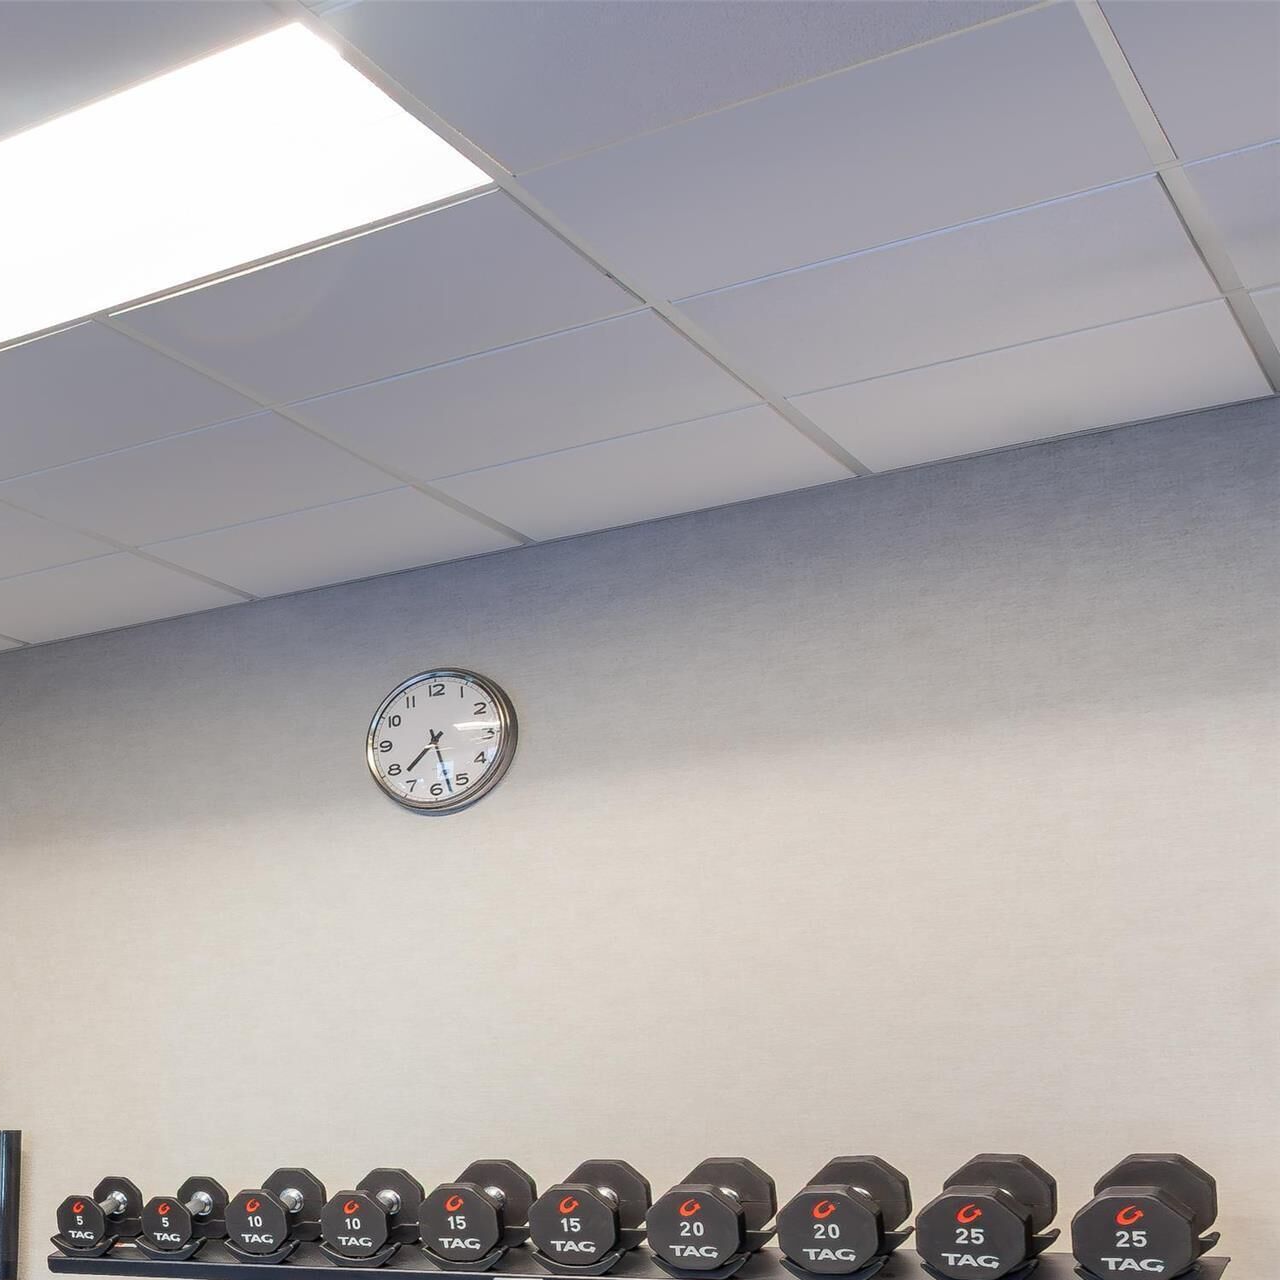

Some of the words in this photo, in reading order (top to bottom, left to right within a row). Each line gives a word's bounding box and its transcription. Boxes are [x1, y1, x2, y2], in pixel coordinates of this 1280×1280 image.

[428, 684, 445, 697] 12
[406, 696, 415, 708] 11
[474, 702, 487, 715] 2
[388, 715, 401, 728] 10
[379, 741, 393, 752] 9
[474, 751, 487, 764] 4
[388, 764, 402, 776] 8
[456, 773, 469, 786] 5
[406, 780, 418, 792] 7
[430, 783, 442, 796] 6
[77, 1216, 83, 1225] 5
[162, 1217, 169, 1227] 5
[248, 1216, 262, 1227] 10
[345, 1218, 360, 1229] 10
[448, 1216, 466, 1229] 15
[561, 1218, 580, 1232] 15
[68, 1231, 94, 1239] TAG
[680, 1222, 704, 1236] 20
[814, 1224, 839, 1238] 20
[154, 1232, 180, 1242] TAG
[241, 1234, 273, 1244] TAG
[338, 1237, 372, 1247] TAG
[956, 1228, 984, 1244] 25
[1116, 1231, 1147, 1247] 25
[439, 1238, 480, 1249] TAG
[551, 1241, 596, 1253] TAG
[669, 1245, 718, 1258] TAG
[803, 1249, 856, 1261] TAG
[941, 1253, 999, 1268] TAG
[1101, 1258, 1164, 1272] TAG
